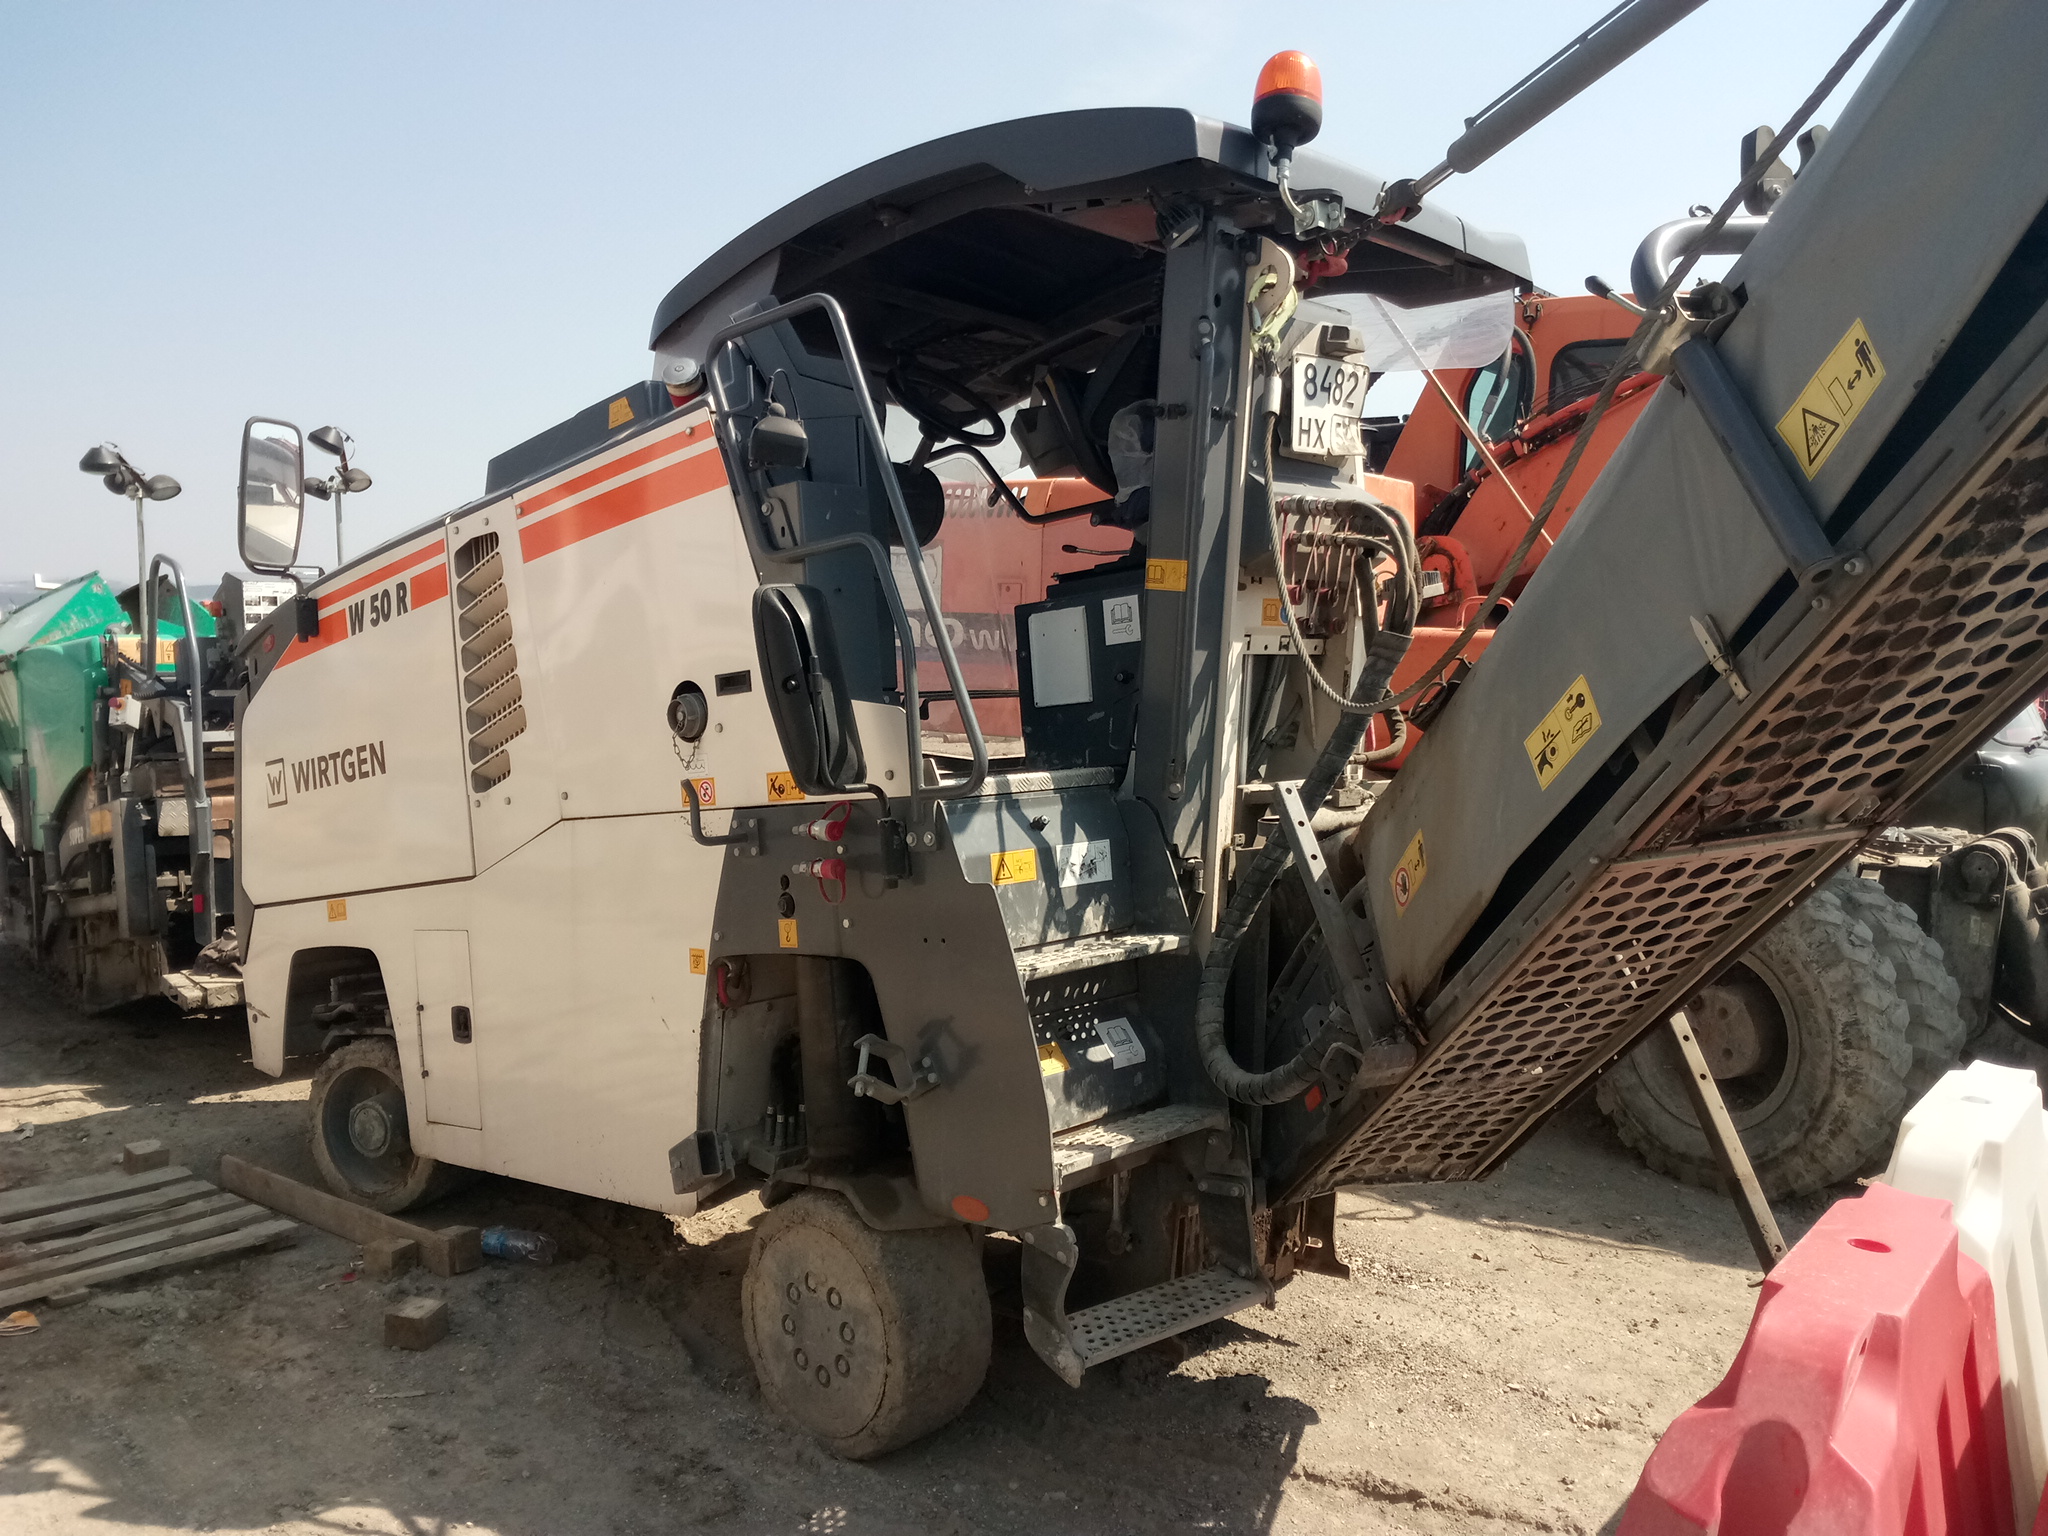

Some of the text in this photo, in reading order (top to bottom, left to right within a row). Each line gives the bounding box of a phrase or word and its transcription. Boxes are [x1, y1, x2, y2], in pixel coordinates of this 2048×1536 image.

[1303, 363, 1359, 410] 8482
[348, 581, 409, 636] W 50 R
[291, 740, 387, 794] WIRTGEN
